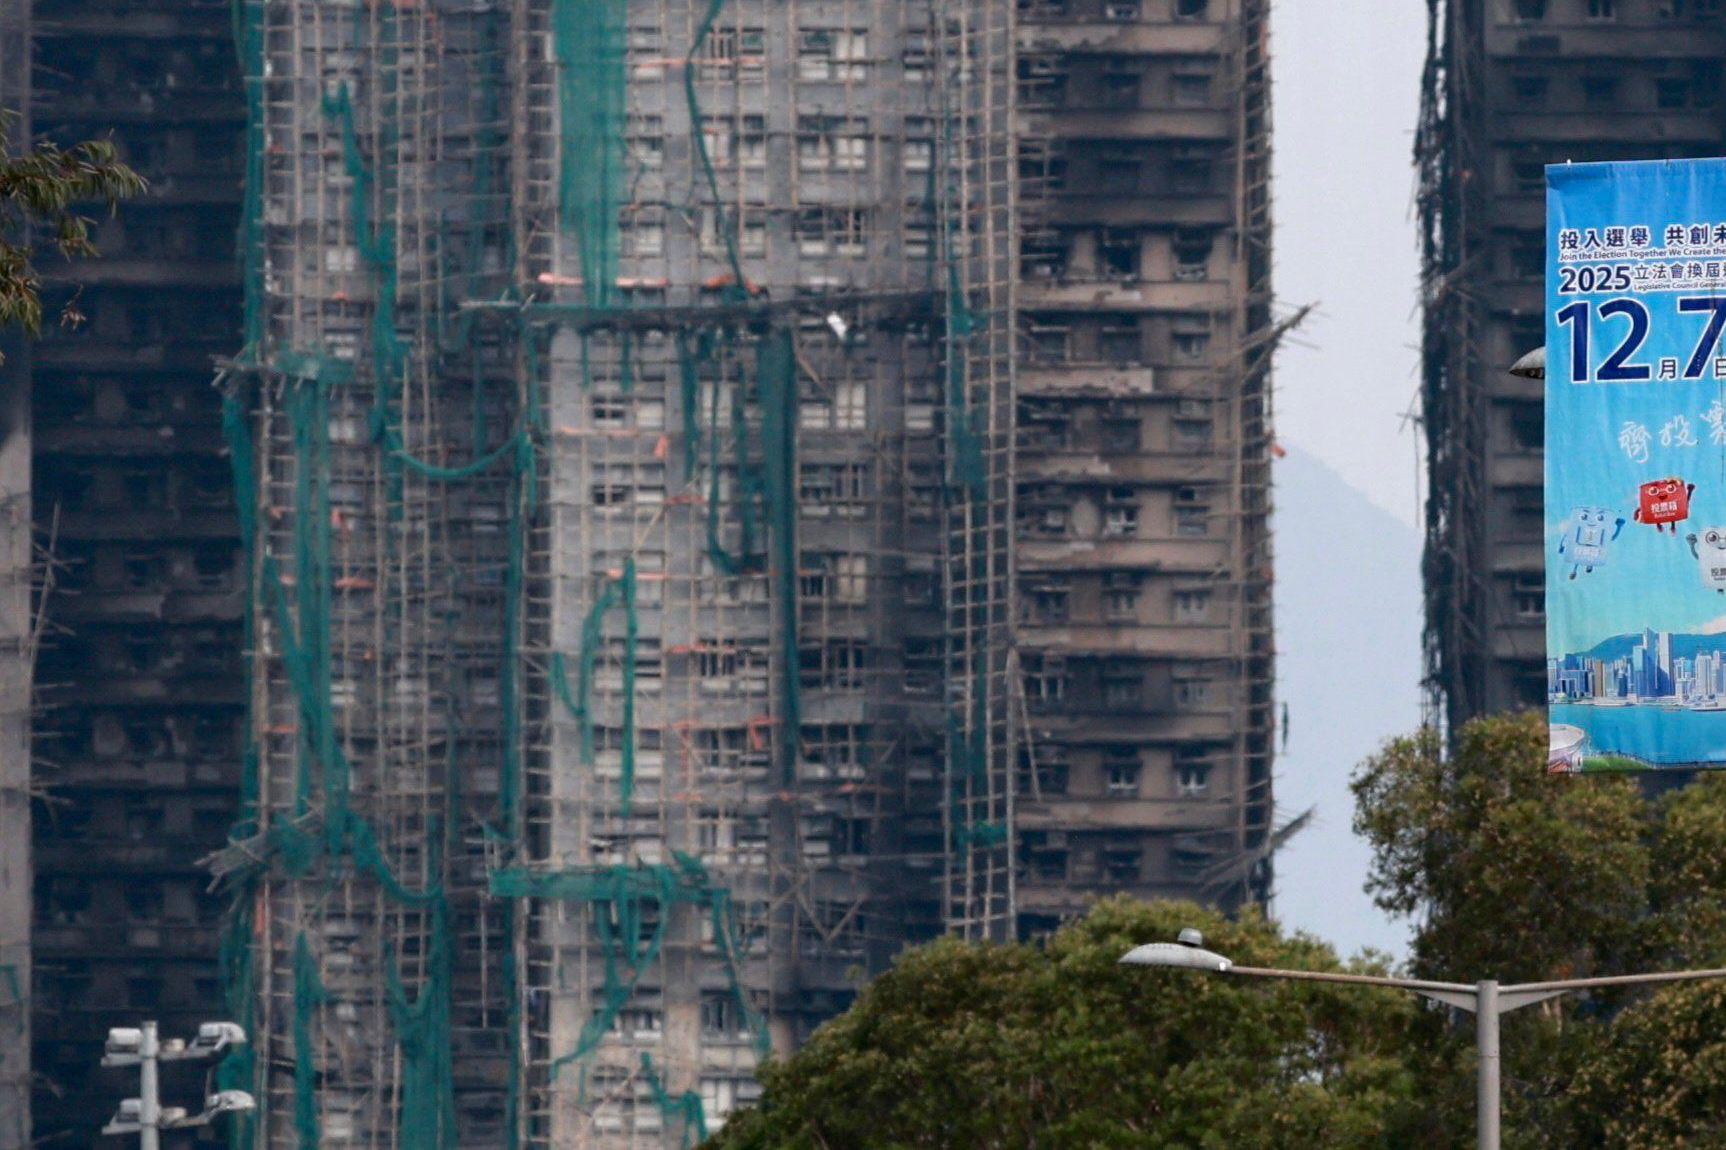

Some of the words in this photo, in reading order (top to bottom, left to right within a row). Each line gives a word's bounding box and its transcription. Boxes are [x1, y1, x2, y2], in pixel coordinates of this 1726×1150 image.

[1560, 227, 1649, 249] 投入選舉
[1560, 252, 1578, 261] Join
[1579, 252, 1593, 260] the
[1593, 250, 1628, 259] Election
[1629, 249, 1667, 259] Together
[1668, 249, 1682, 257] We
[1683, 248, 1712, 256] Create
[1713, 247, 1726, 255] the
[1559, 265, 1631, 292] 2025
[1672, 282, 1699, 290] Council
[1699, 281, 1726, 289] General
